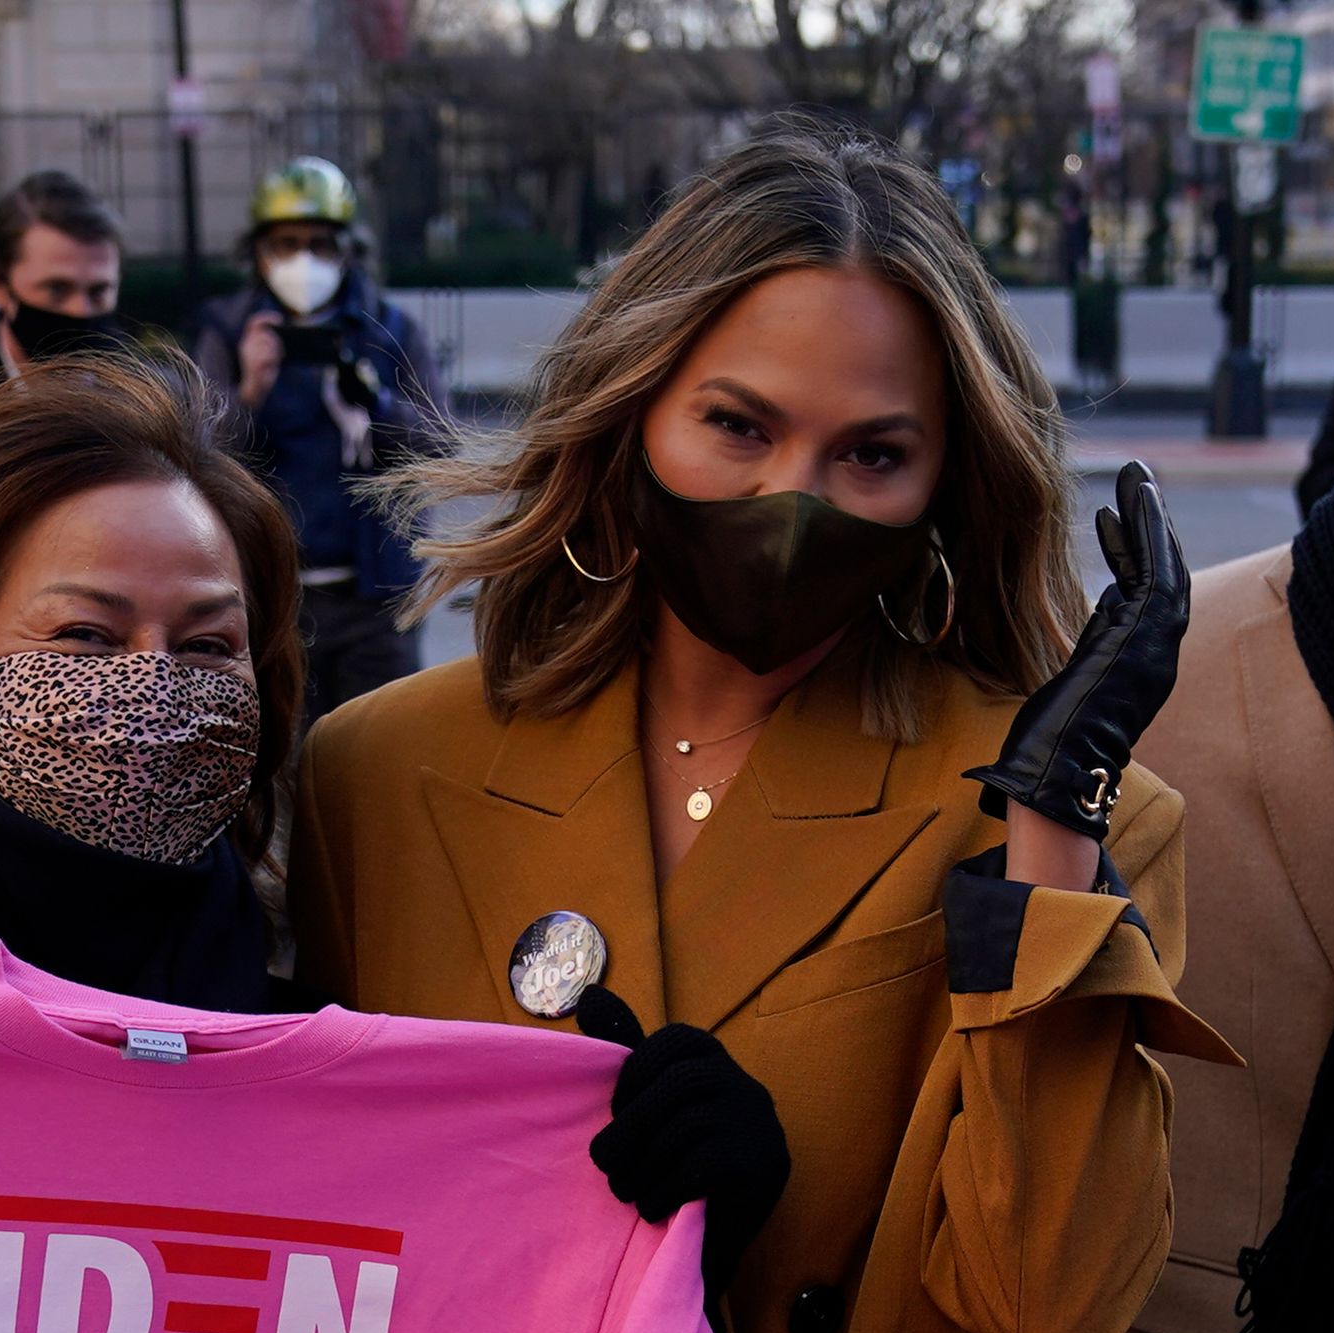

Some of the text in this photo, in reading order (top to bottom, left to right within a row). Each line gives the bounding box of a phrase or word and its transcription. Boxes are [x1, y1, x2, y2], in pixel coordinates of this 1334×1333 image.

[523, 934, 583, 967] We did it
[520, 951, 585, 995] Joe!
[133, 1037, 182, 1049] GILDAN
